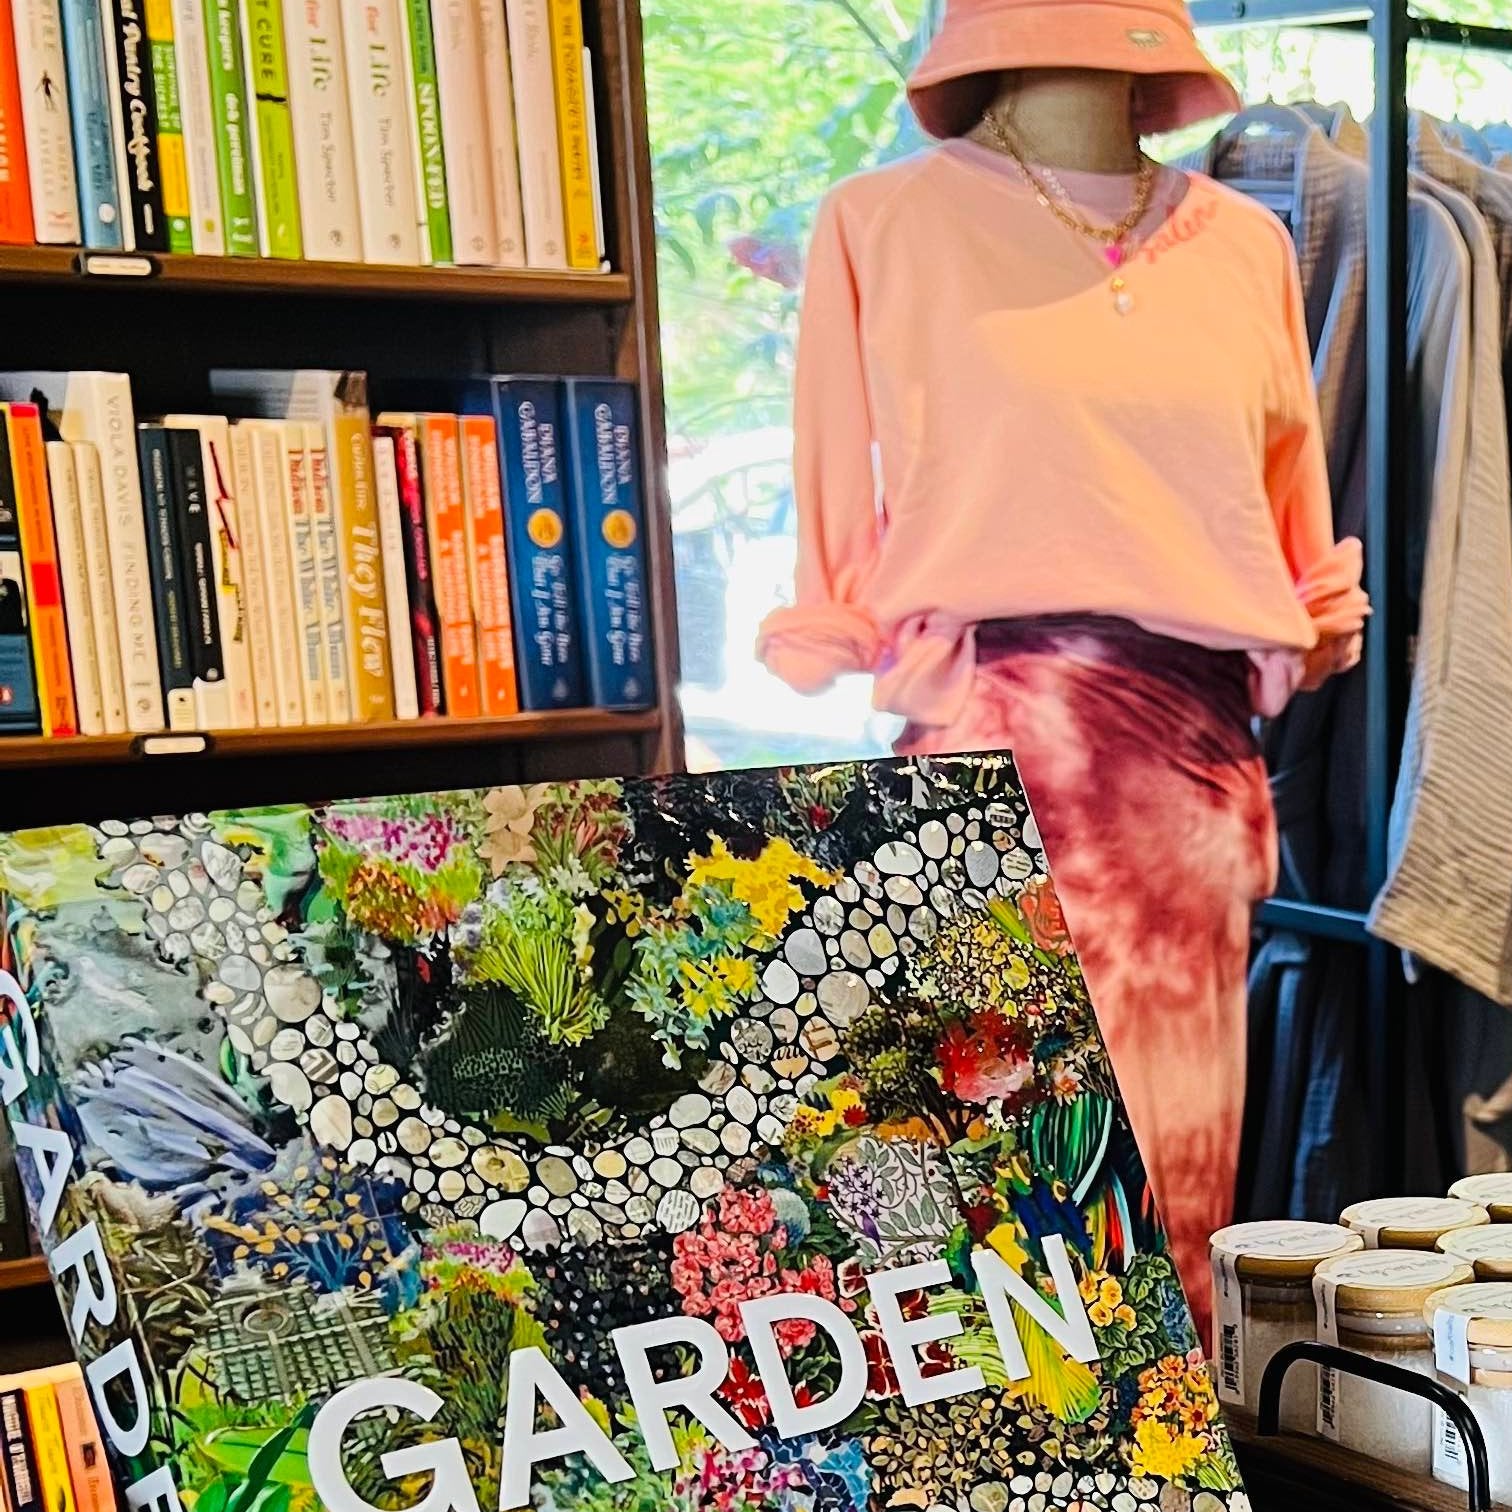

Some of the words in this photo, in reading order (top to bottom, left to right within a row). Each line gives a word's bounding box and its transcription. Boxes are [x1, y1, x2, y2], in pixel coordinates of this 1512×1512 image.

[256, 18, 275, 80] CURE
[309, 38, 331, 92] Life
[369, 45, 391, 97] Life
[107, 394, 125, 459] VIOLA
[537, 422, 558, 485] DIANA
[612, 424, 632, 485] DIANA
[113, 464, 133, 527] DAVIS
[122, 540, 142, 629] FINDING
[347, 521, 379, 598] They
[358, 605, 386, 678] Flew
